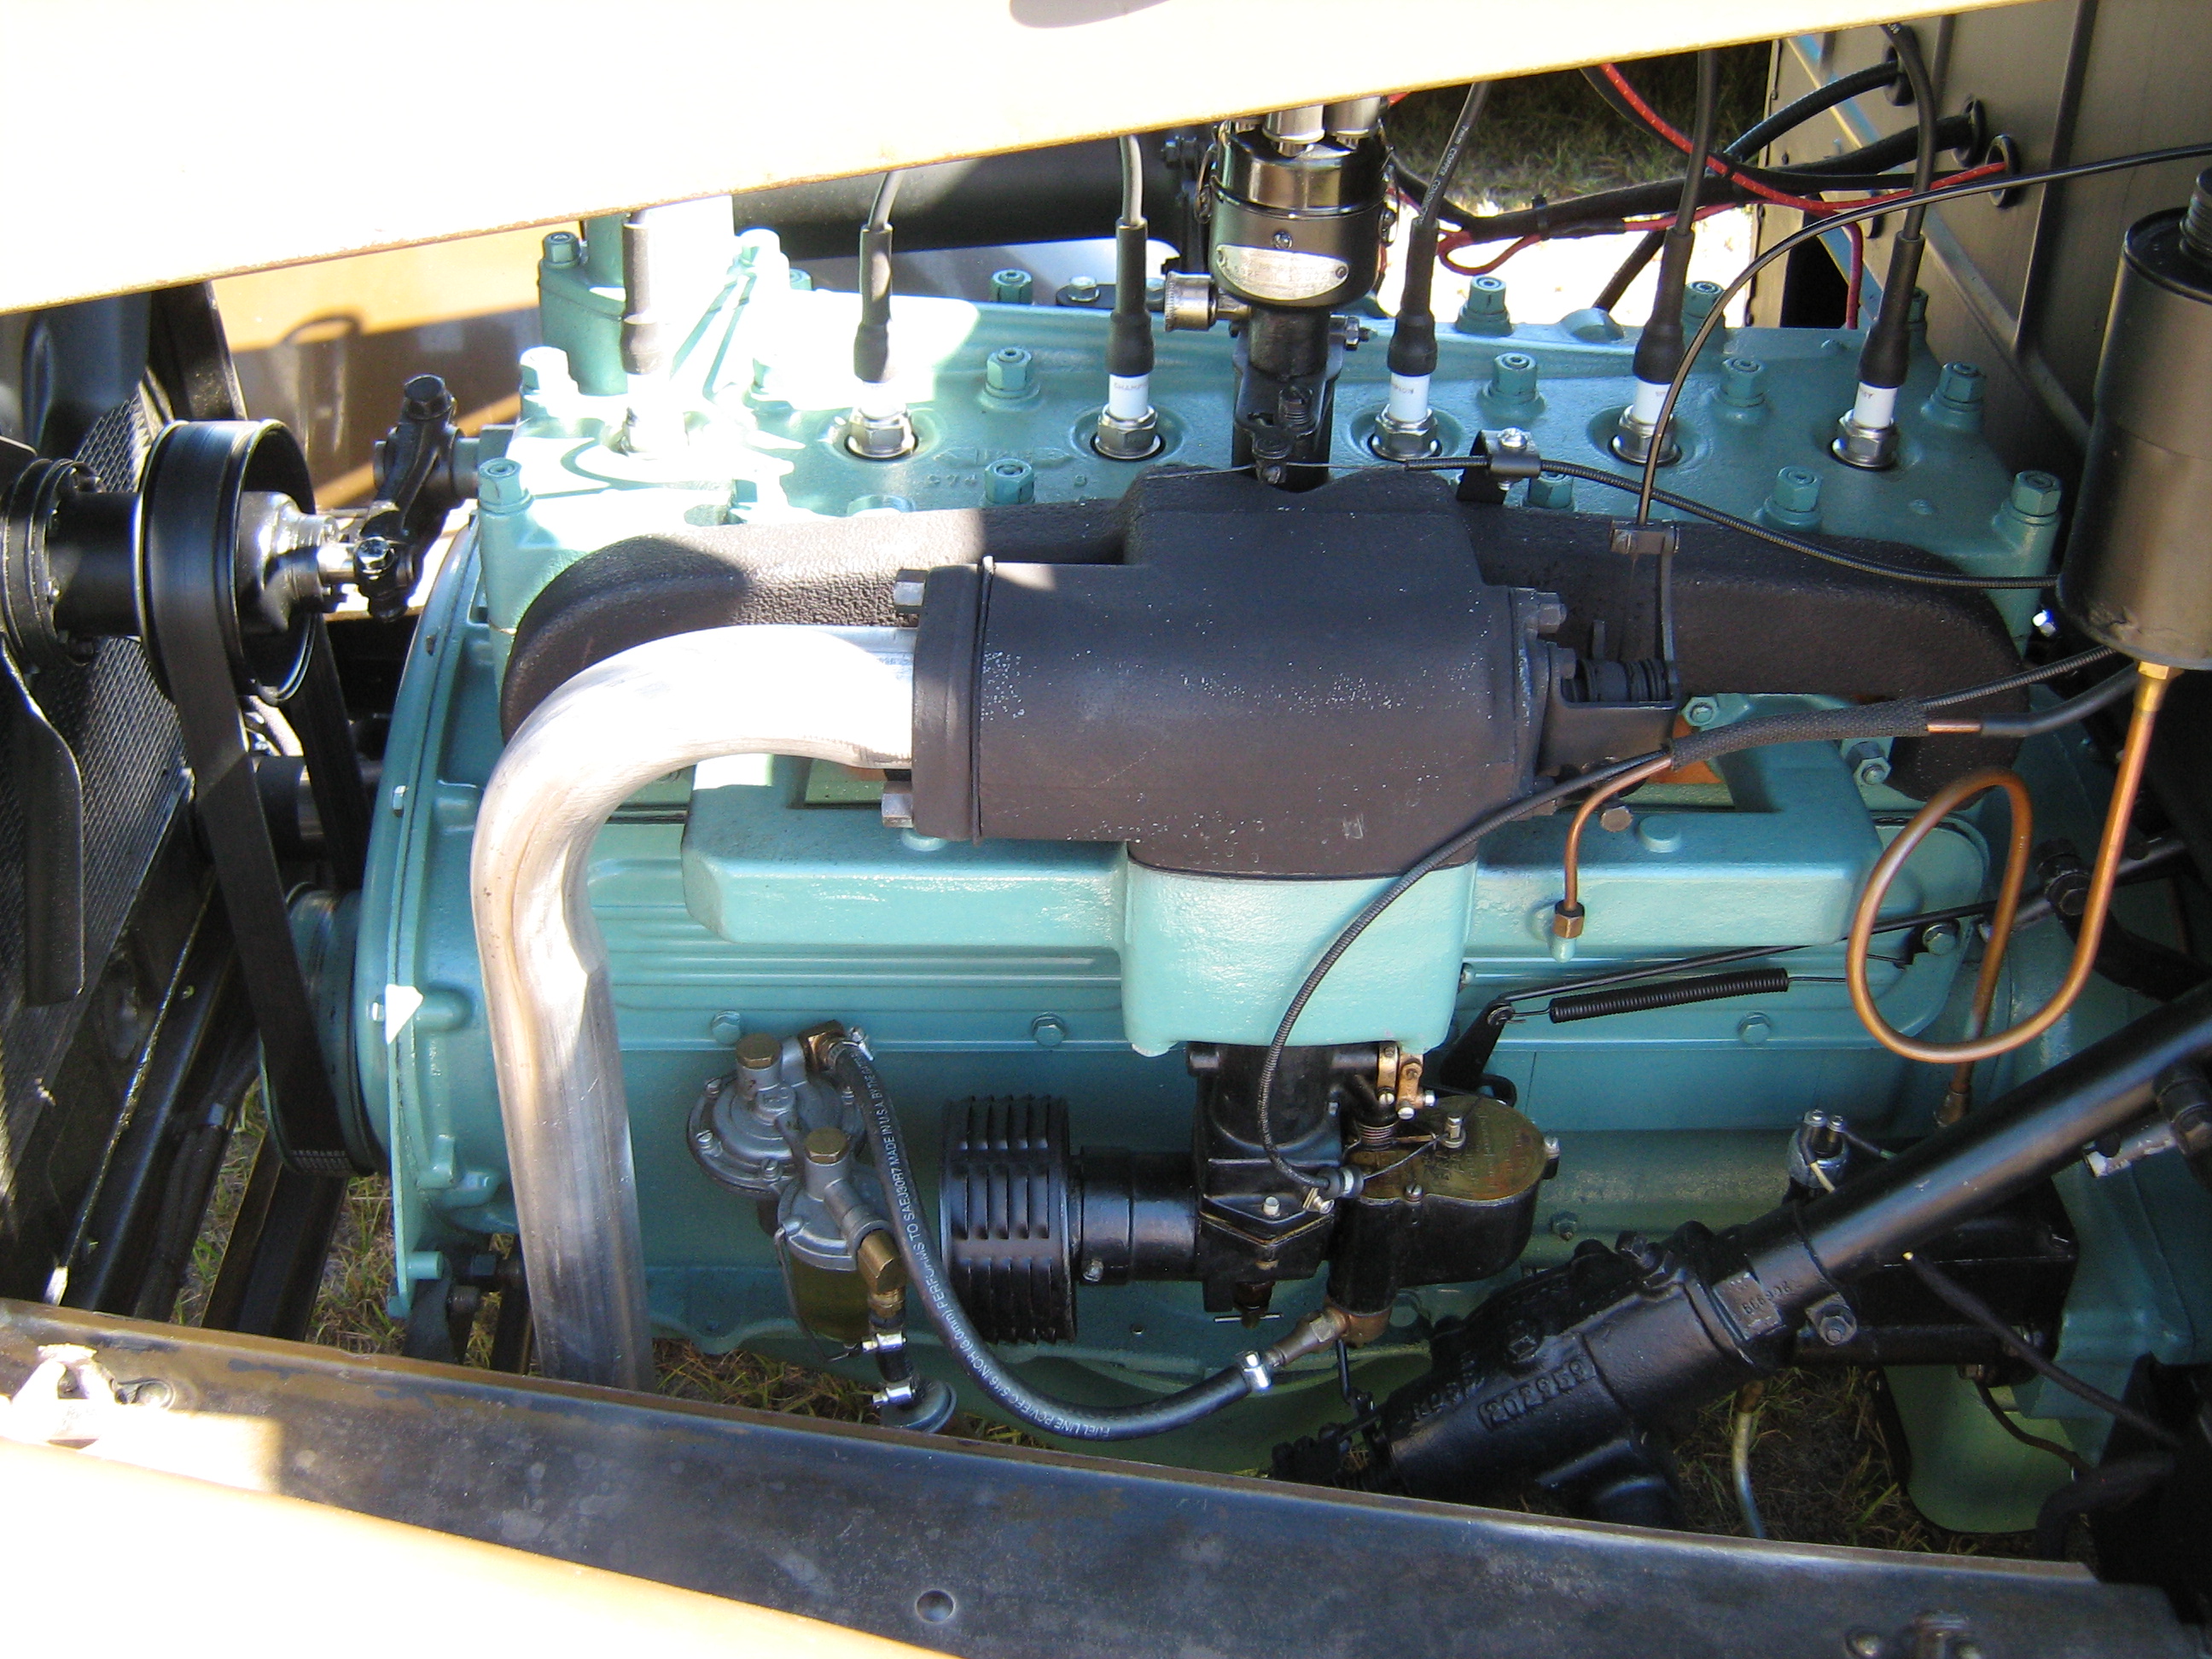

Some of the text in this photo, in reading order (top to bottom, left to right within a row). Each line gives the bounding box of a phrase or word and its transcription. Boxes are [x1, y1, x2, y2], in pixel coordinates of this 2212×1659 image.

[880, 1125, 893, 1135] IN
[883, 1136, 900, 1166] MADE
[906, 1223, 921, 1242] TO
[941, 1308, 974, 1353] (8.0mm)
[967, 1351, 992, 1379] INCH
[1054, 1417, 1080, 1435] LINE
[1083, 1426, 1110, 1438] FUEL
